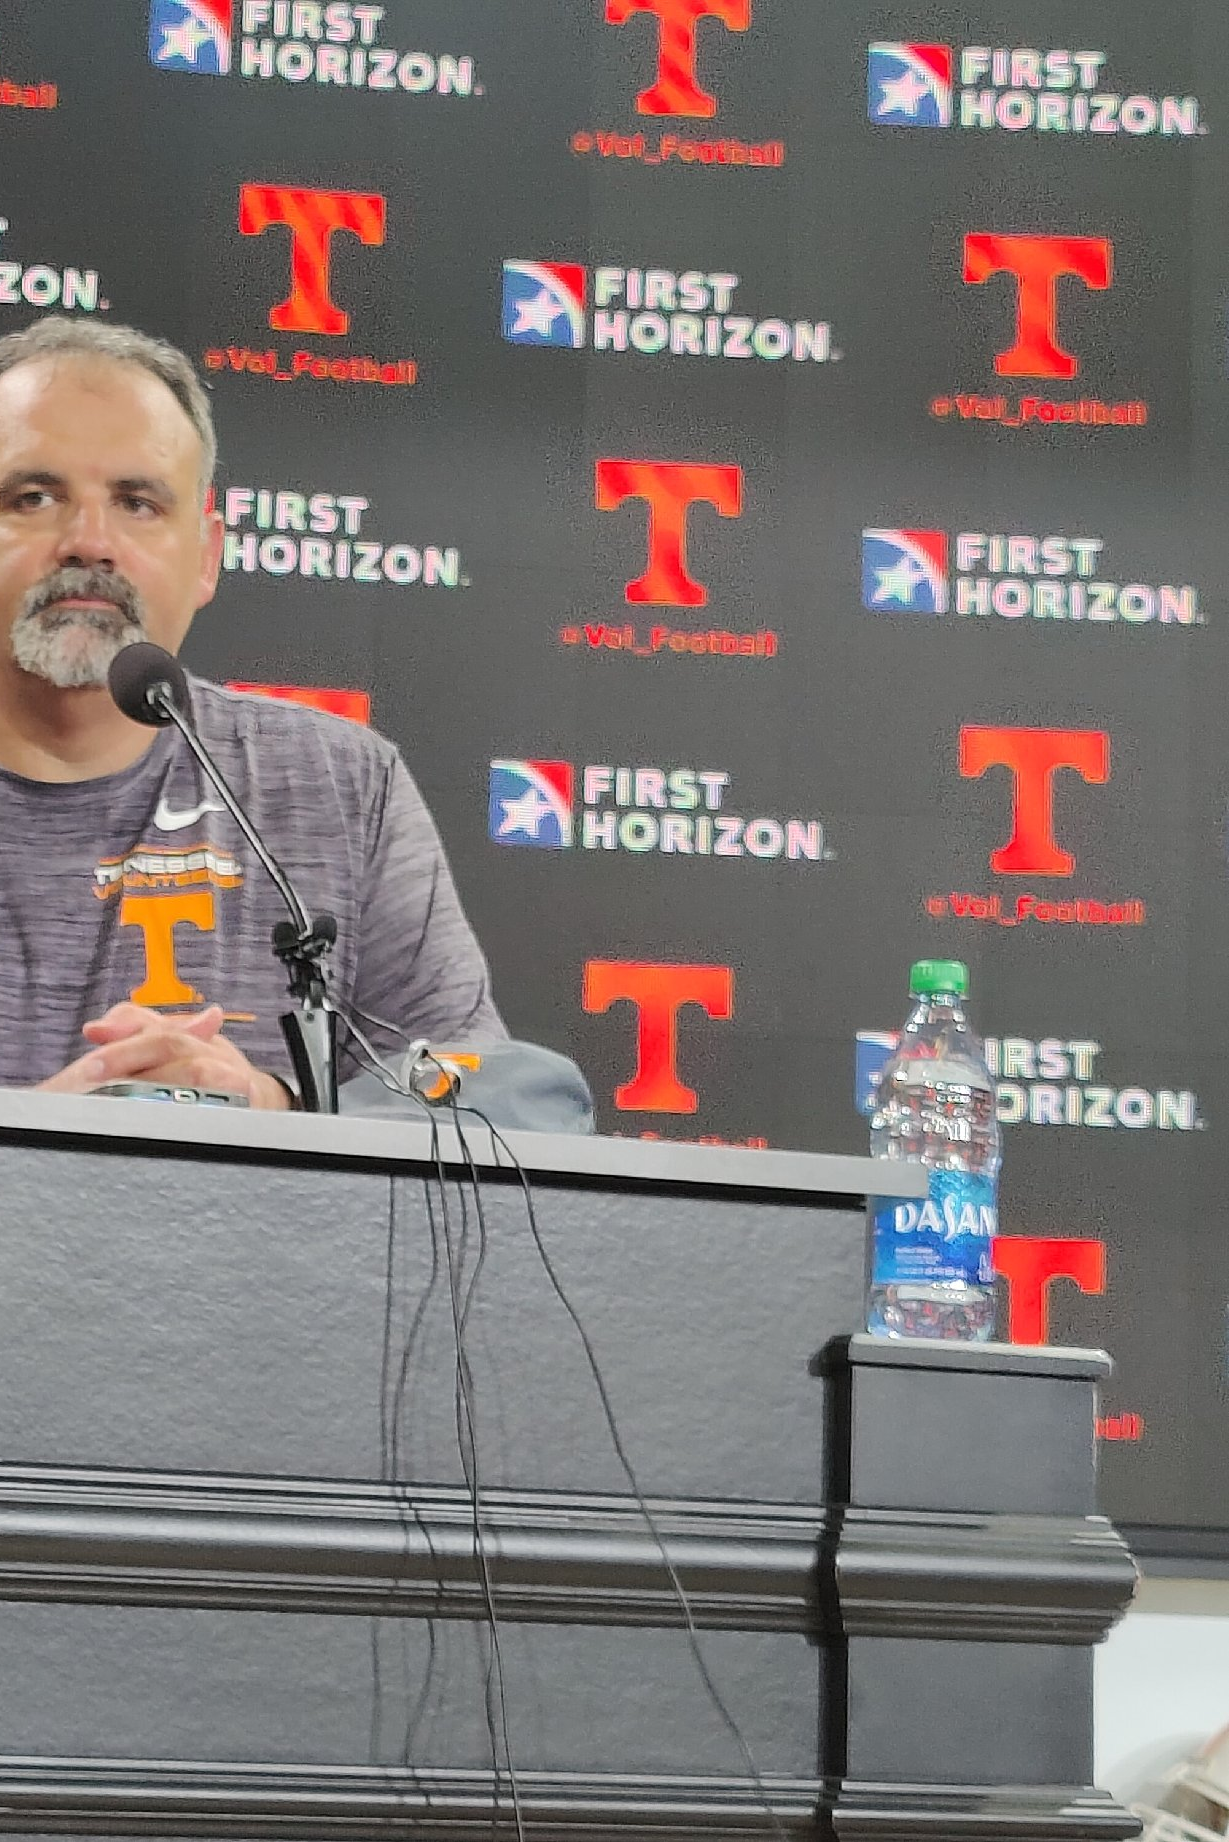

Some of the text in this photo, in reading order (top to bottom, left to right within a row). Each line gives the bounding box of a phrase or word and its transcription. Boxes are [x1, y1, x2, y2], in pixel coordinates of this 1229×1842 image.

[240, 0, 385, 45] FIRST
[960, 45, 1107, 91] FIRST
[570, 132, 785, 166] @Vol_Football
[594, 266, 740, 314] FIRST
[204, 347, 418, 386] @Vol_Football
[930, 395, 1148, 427] @Vol_Football
[225, 486, 370, 536] FIRST
[956, 532, 1104, 579] FIRST
[559, 624, 778, 657] @Vol_Football
[583, 764, 730, 812] FIRST
[925, 893, 1145, 926] @Vol_Football
[984, 1037, 1103, 1081] IRST
[894, 1192, 997, 1243] DASAN
